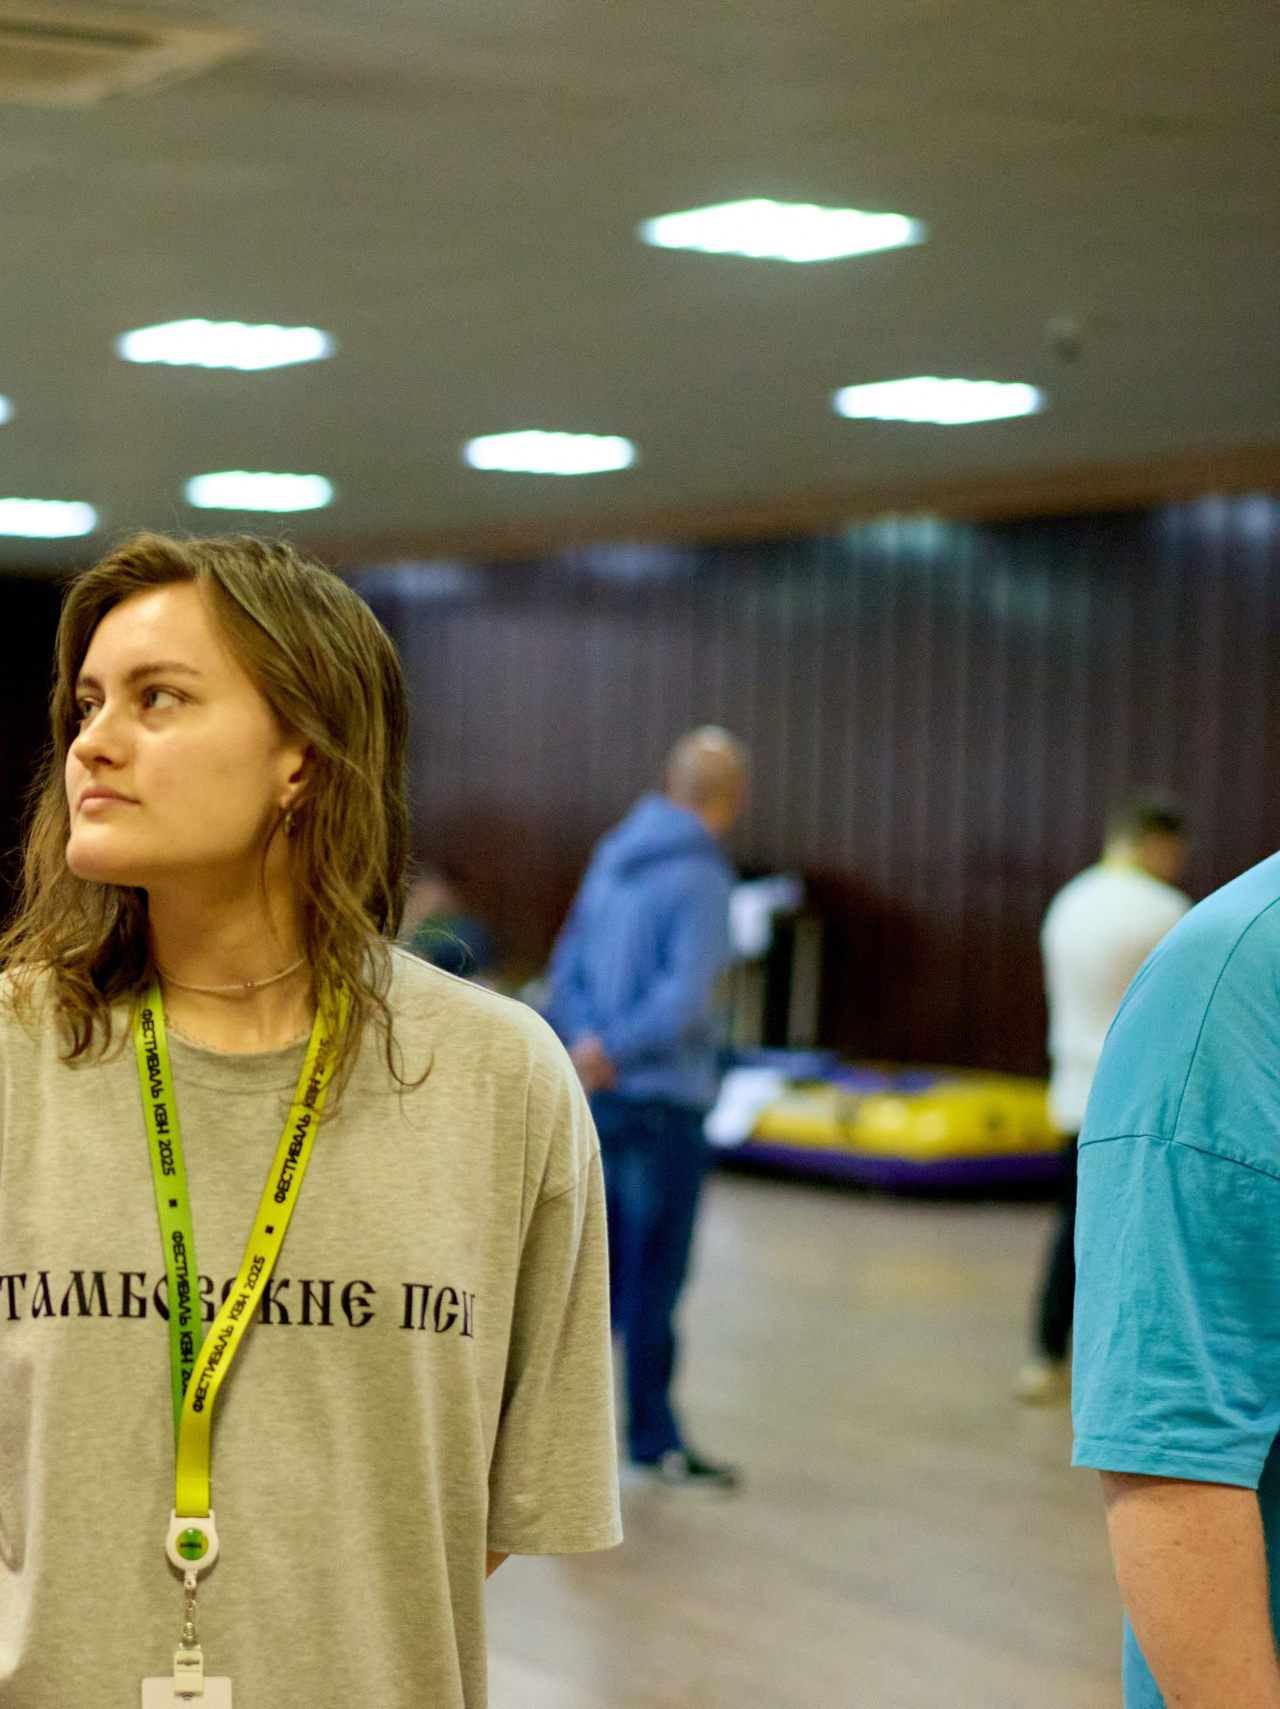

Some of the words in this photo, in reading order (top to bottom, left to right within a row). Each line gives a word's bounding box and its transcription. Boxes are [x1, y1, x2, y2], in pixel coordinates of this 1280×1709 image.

[142, 1008, 164, 1099] ФЕСТИВАЛЬ
[153, 1102, 170, 1135] КВН
[158, 1138, 176, 1177] 2025
[274, 1113, 312, 1204] ФЕСТИВАЛЬ
[172, 1230, 192, 1326] ФЕСТИВАЛЬ
[180, 1331, 194, 1363] КВН
[192, 1324, 235, 1413] ФЕСТИВАЛЬ
[228, 1293, 251, 1322] КВН
[245, 1255, 266, 1291] 2025
